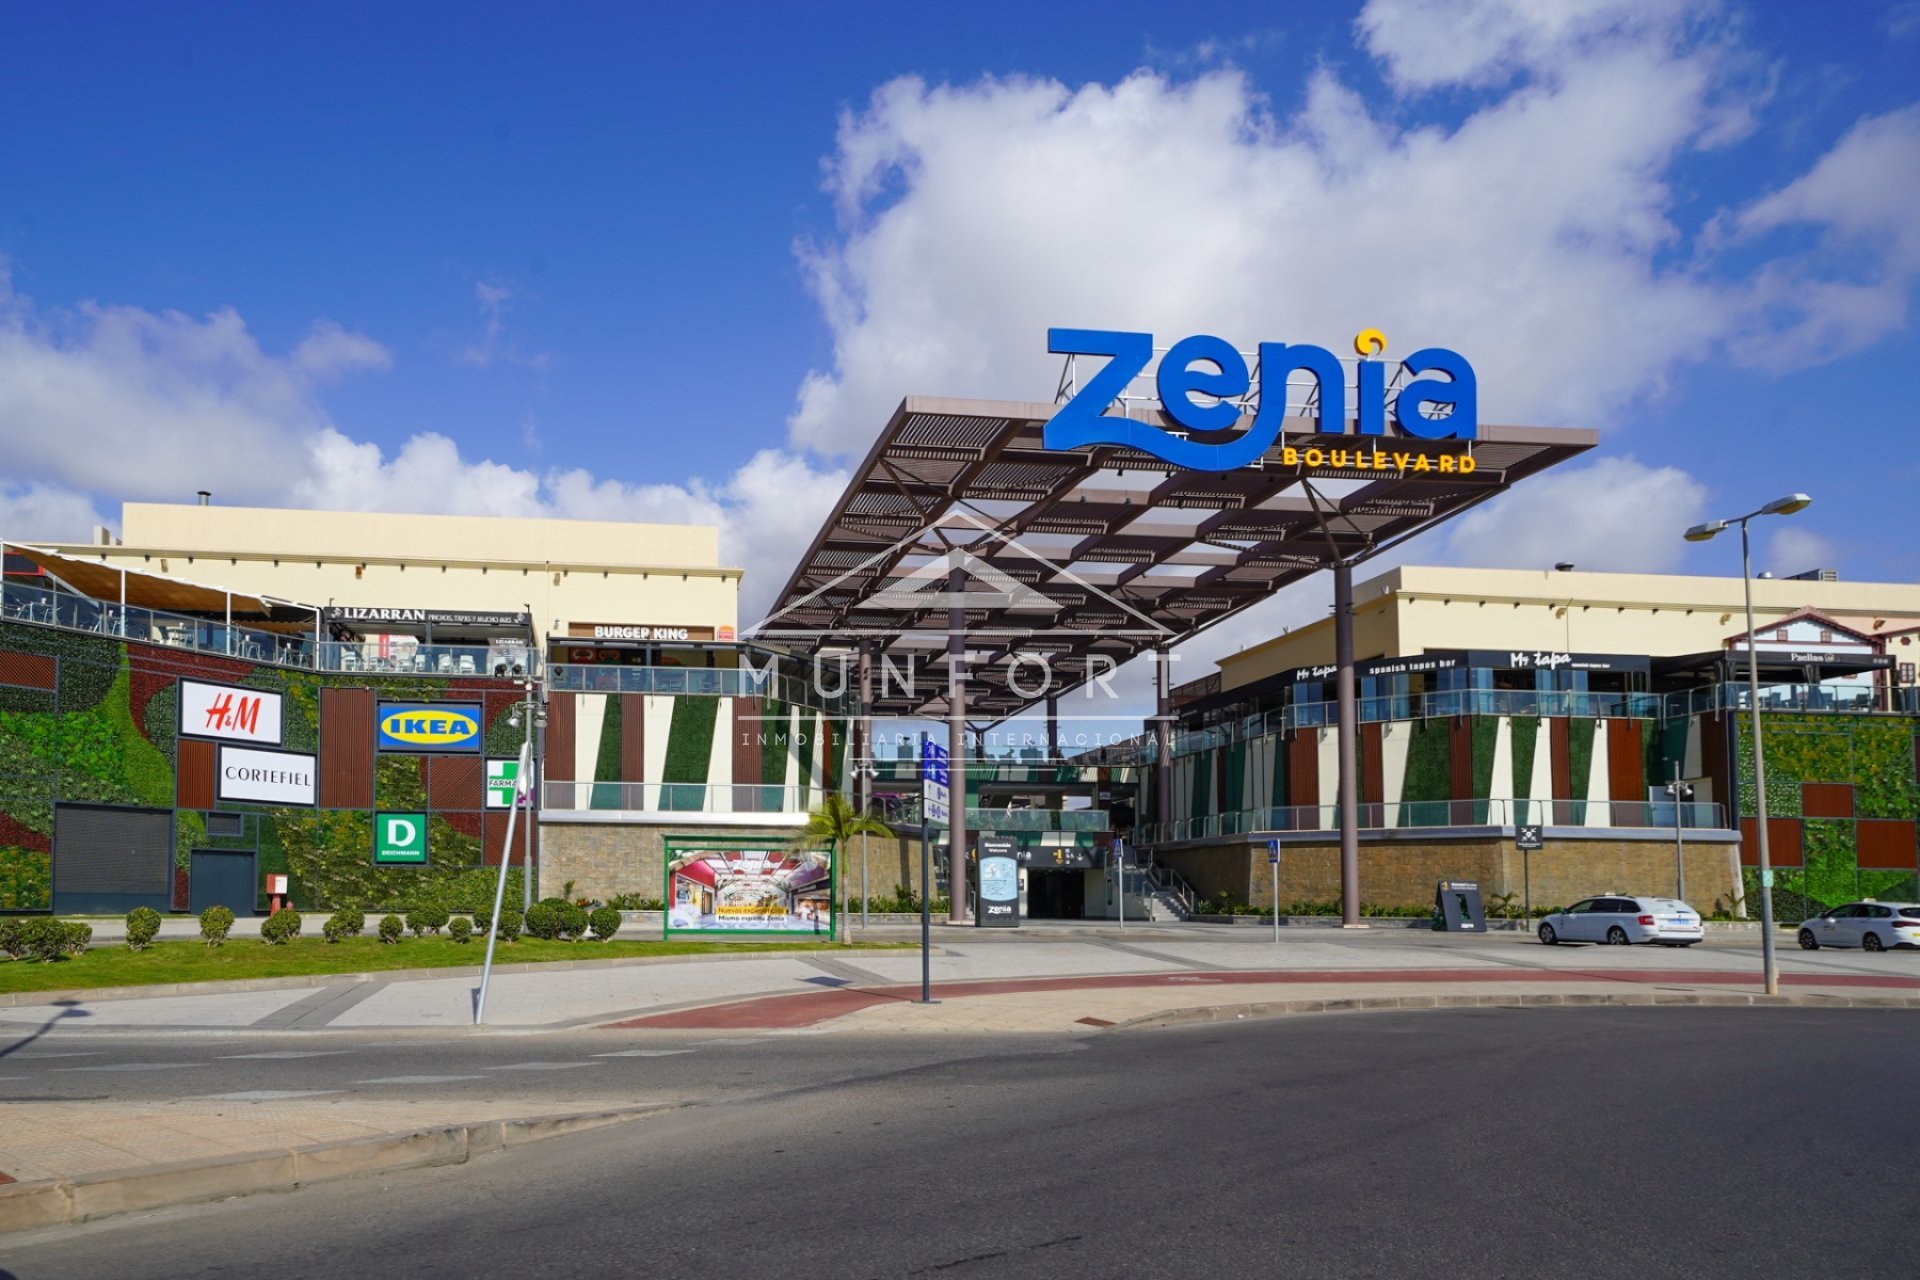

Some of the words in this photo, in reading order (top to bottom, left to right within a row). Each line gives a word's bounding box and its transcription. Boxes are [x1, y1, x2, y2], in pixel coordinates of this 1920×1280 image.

[1282, 447, 1476, 473] BOULEVARD
[344, 607, 425, 620] LIZARRAN
[594, 626, 650, 639] BURGER
[653, 627, 688, 640] KING
[1369, 664, 1406, 675] spanish
[1409, 661, 1436, 671] tapas
[1439, 659, 1456, 668] bar
[1533, 651, 1571, 670] tapa
[205, 692, 261, 735] H&M
[390, 718, 471, 735] IKEA
[225, 766, 311, 787] CORTEFIEL
[387, 819, 416, 847] D
